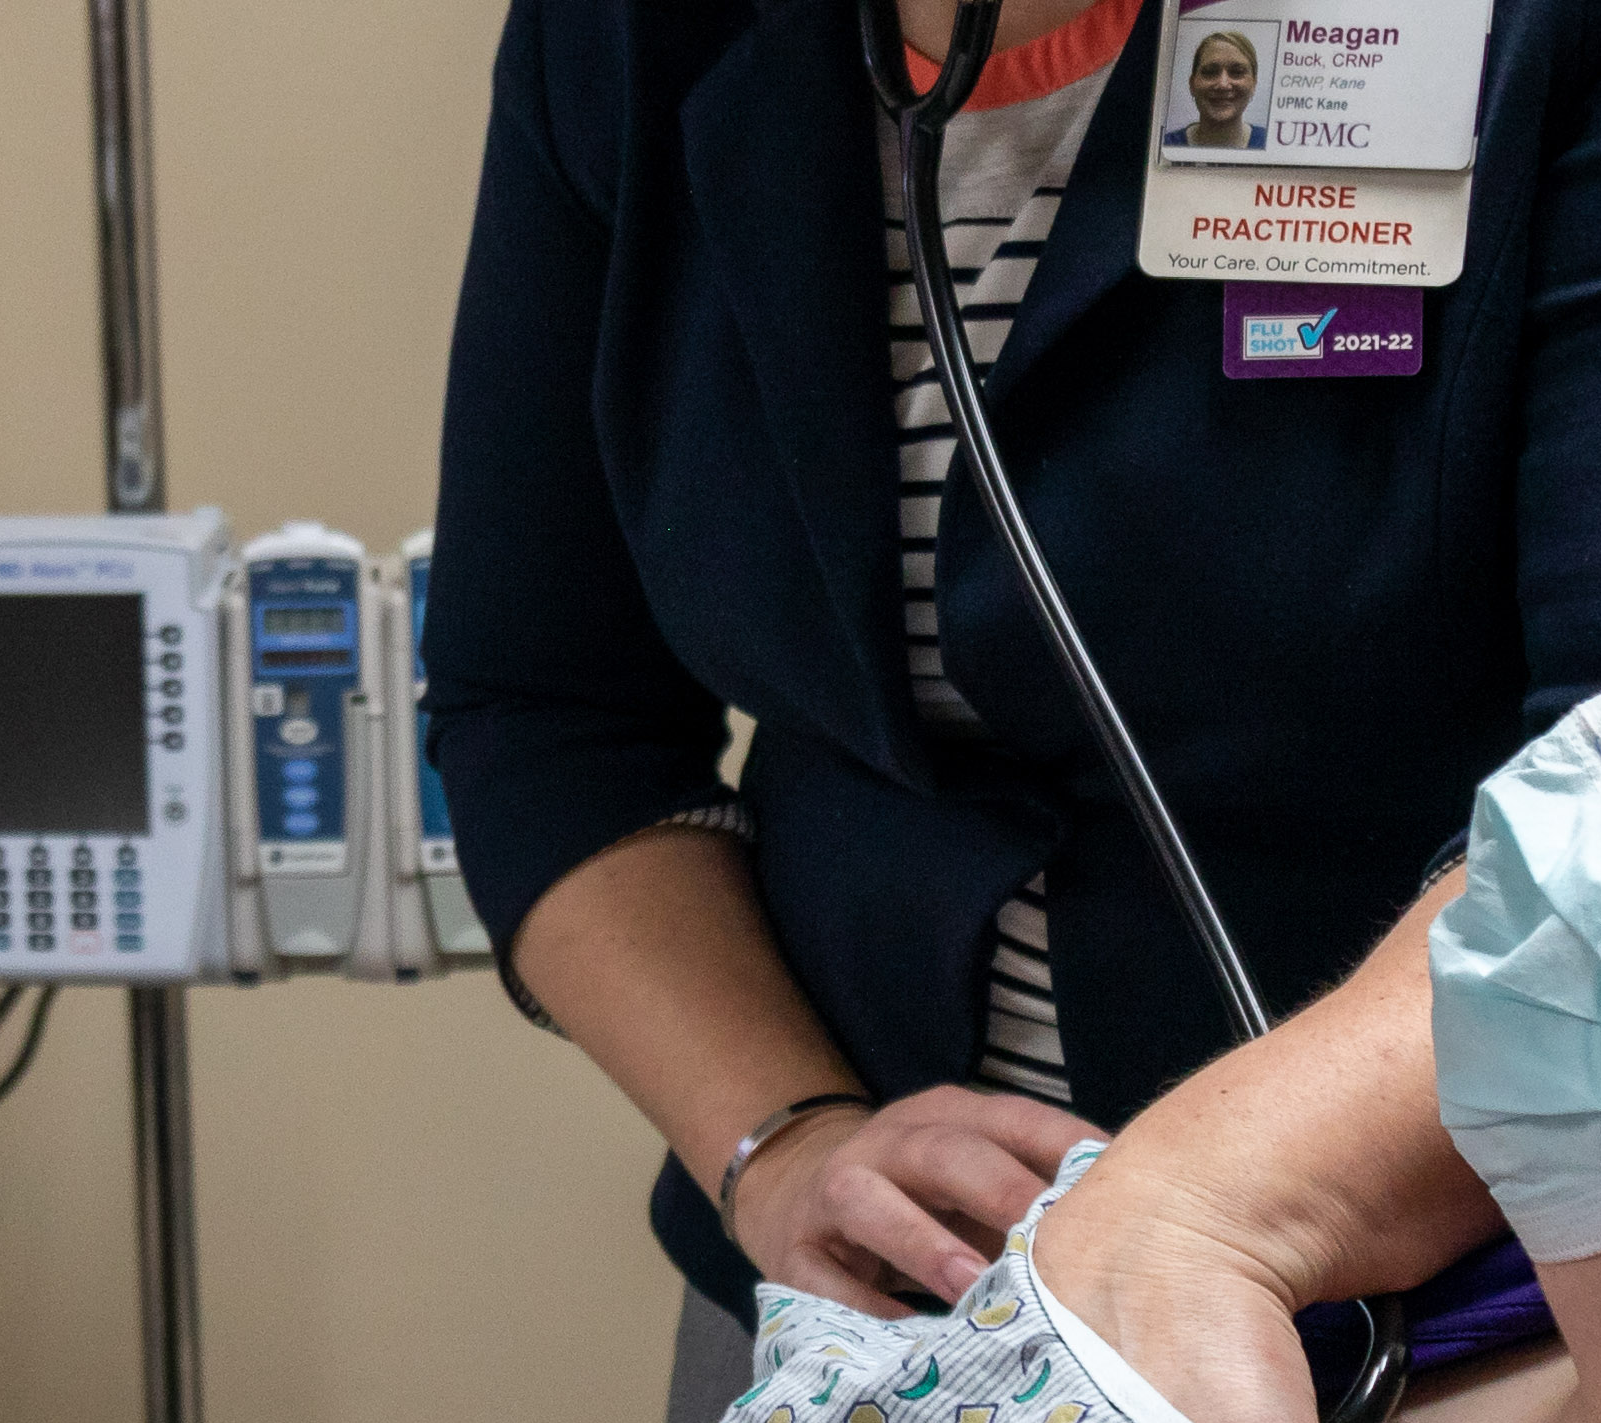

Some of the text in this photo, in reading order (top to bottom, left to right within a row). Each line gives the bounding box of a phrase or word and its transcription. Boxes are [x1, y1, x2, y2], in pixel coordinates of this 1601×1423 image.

[1286, 19, 1400, 51] Meagan
[1282, 51, 1384, 70] Buck, CRNP
[1280, 74, 1366, 91] CRNP, Kane
[1276, 96, 1349, 111] UPMC Kane
[1275, 120, 1371, 149] UPMC
[1254, 183, 1358, 209] NURSE
[1192, 216, 1413, 246] PRACTITIONER
[1168, 253, 1431, 277] Your Care. Our Commitment.
[1250, 322, 1284, 336] FLU
[1250, 338, 1298, 353] SHOT
[1333, 334, 1414, 352] 2021-22
